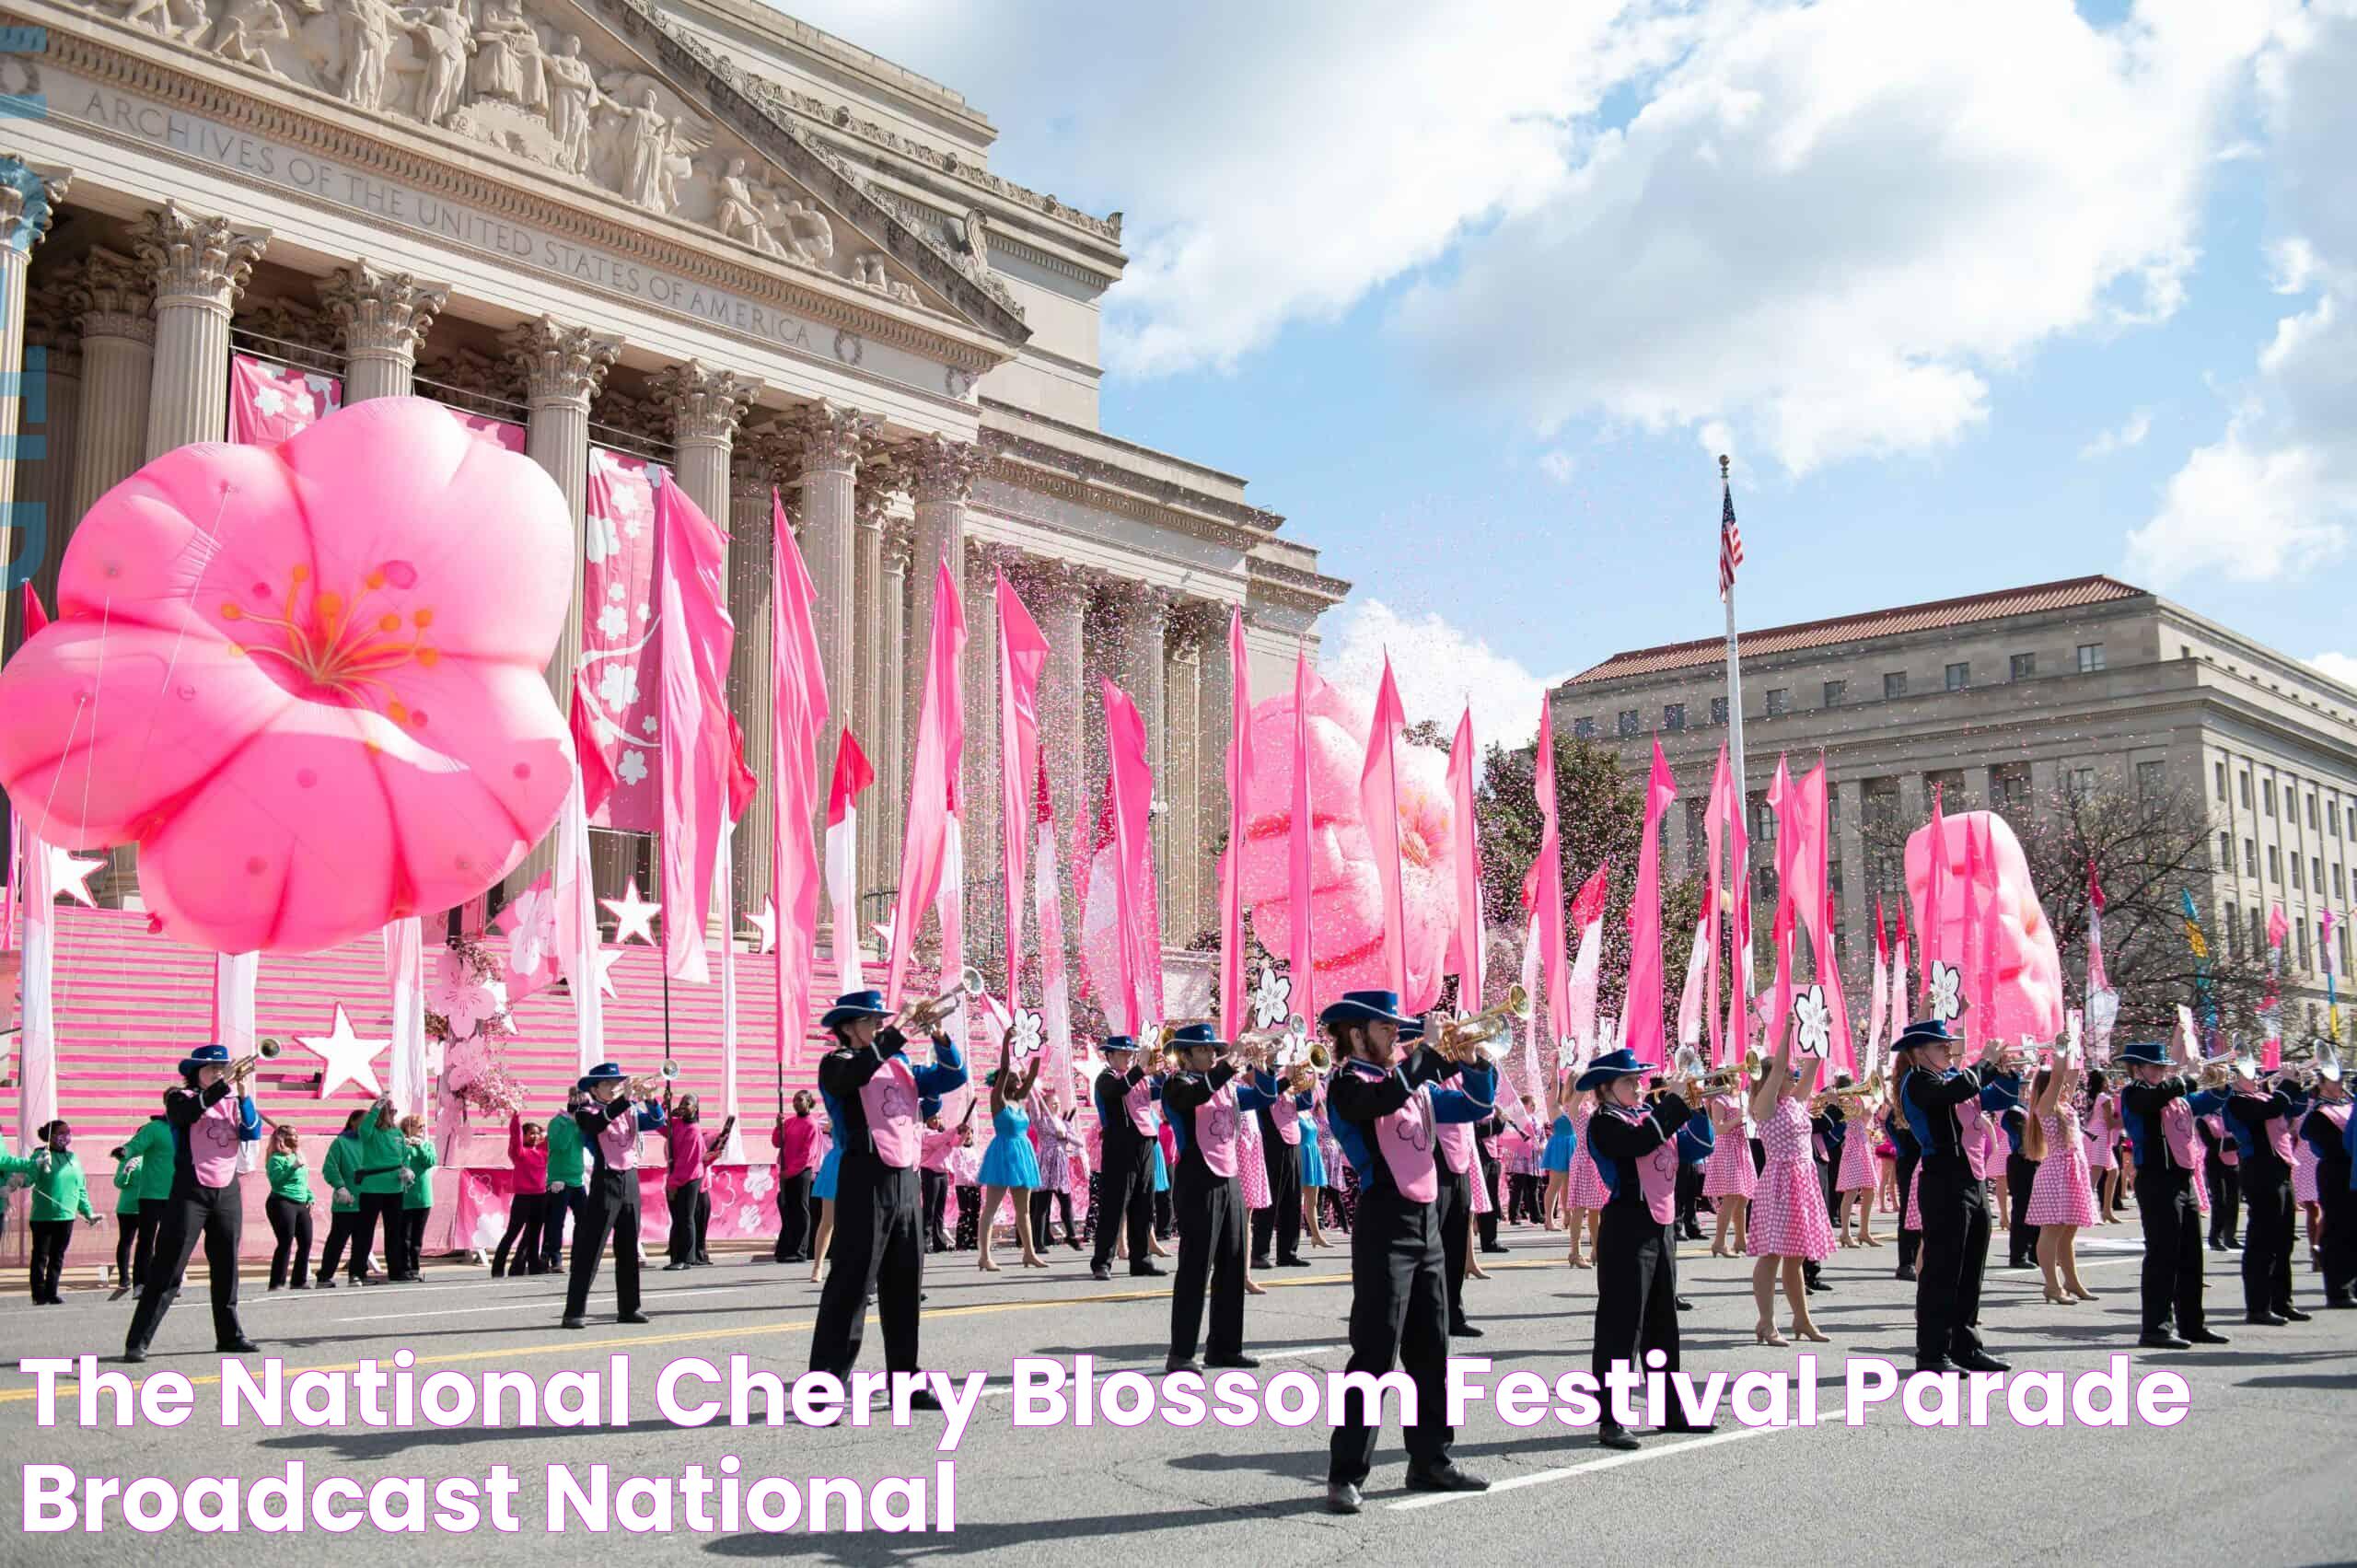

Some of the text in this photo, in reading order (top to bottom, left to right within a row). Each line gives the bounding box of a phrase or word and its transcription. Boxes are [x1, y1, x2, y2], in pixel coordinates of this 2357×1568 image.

[87, 90, 809, 348] ARCHIVES OF THE UNITED STATES OF AMERICA
